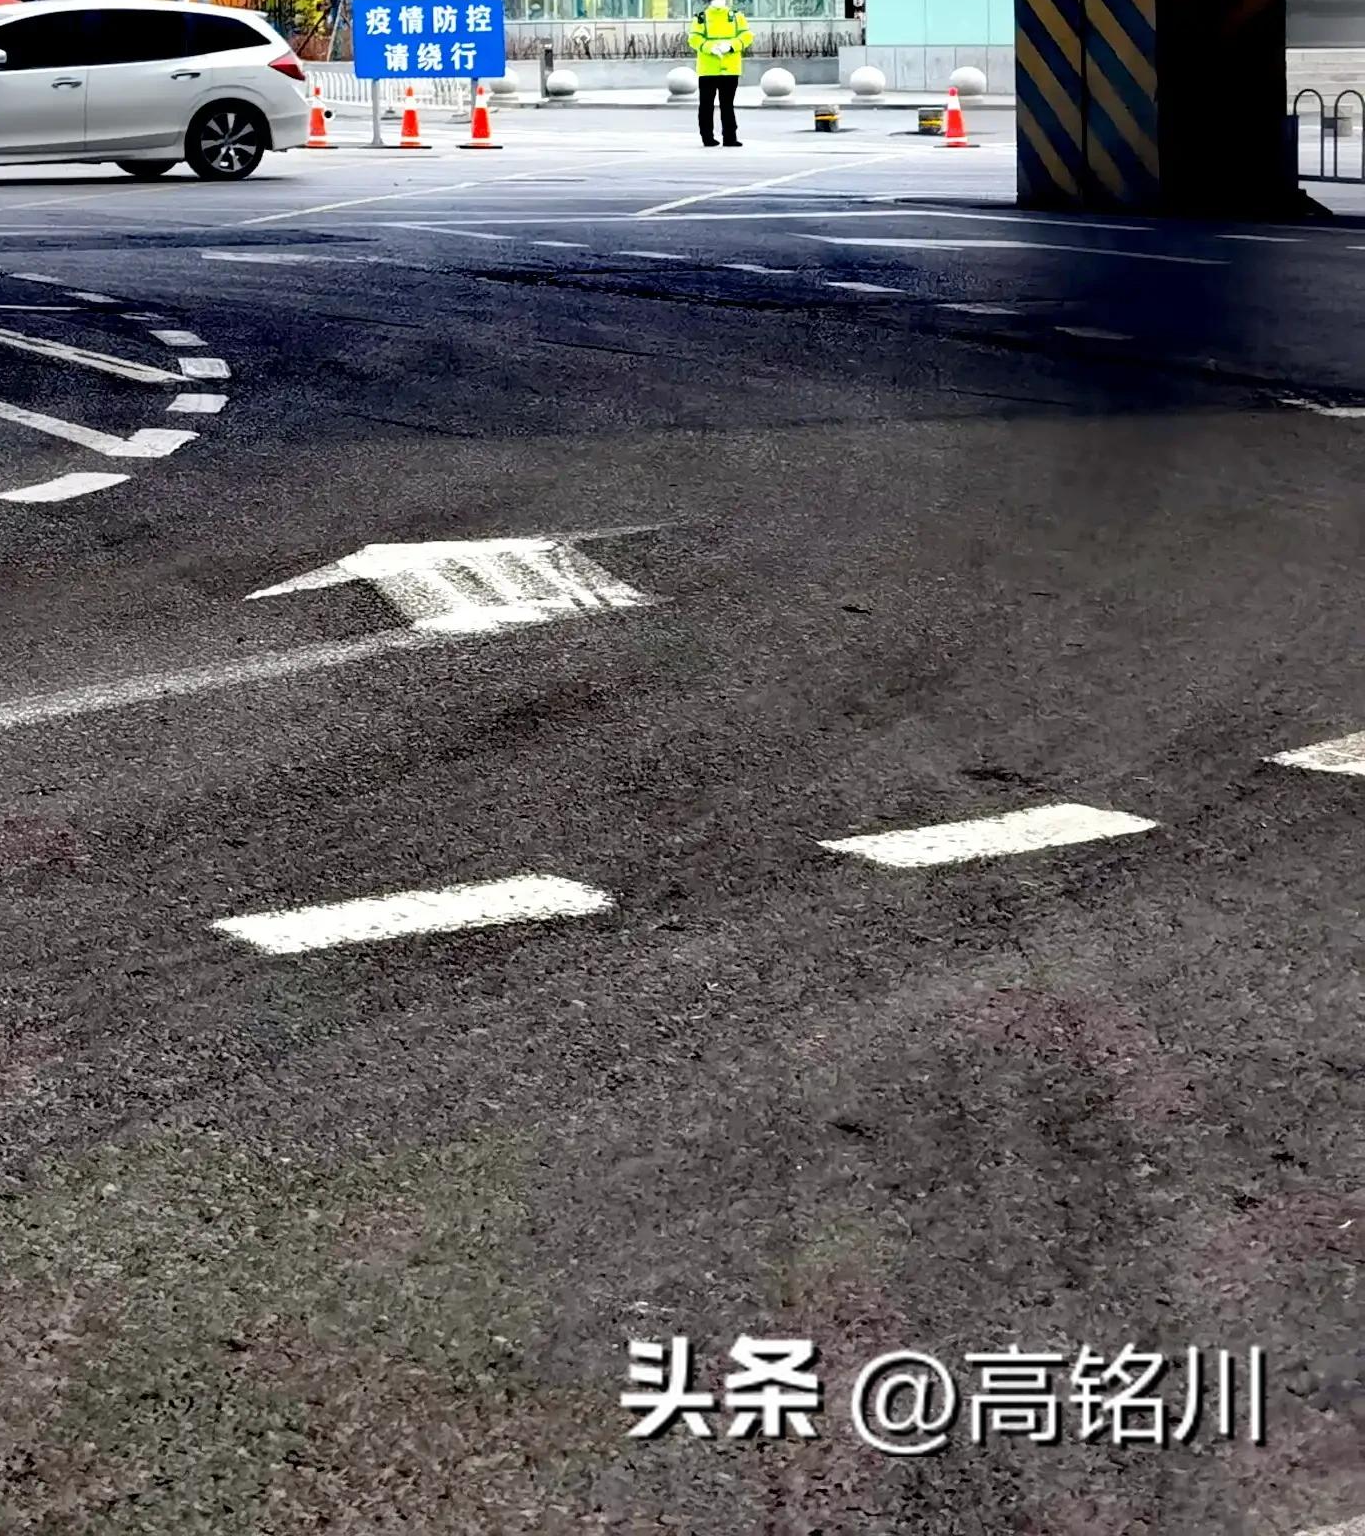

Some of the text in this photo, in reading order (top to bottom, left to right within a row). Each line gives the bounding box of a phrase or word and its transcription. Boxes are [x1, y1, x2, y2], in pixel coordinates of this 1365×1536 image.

[365, 4, 493, 35] 疫情防控
[383, 42, 477, 72] 请绕行
